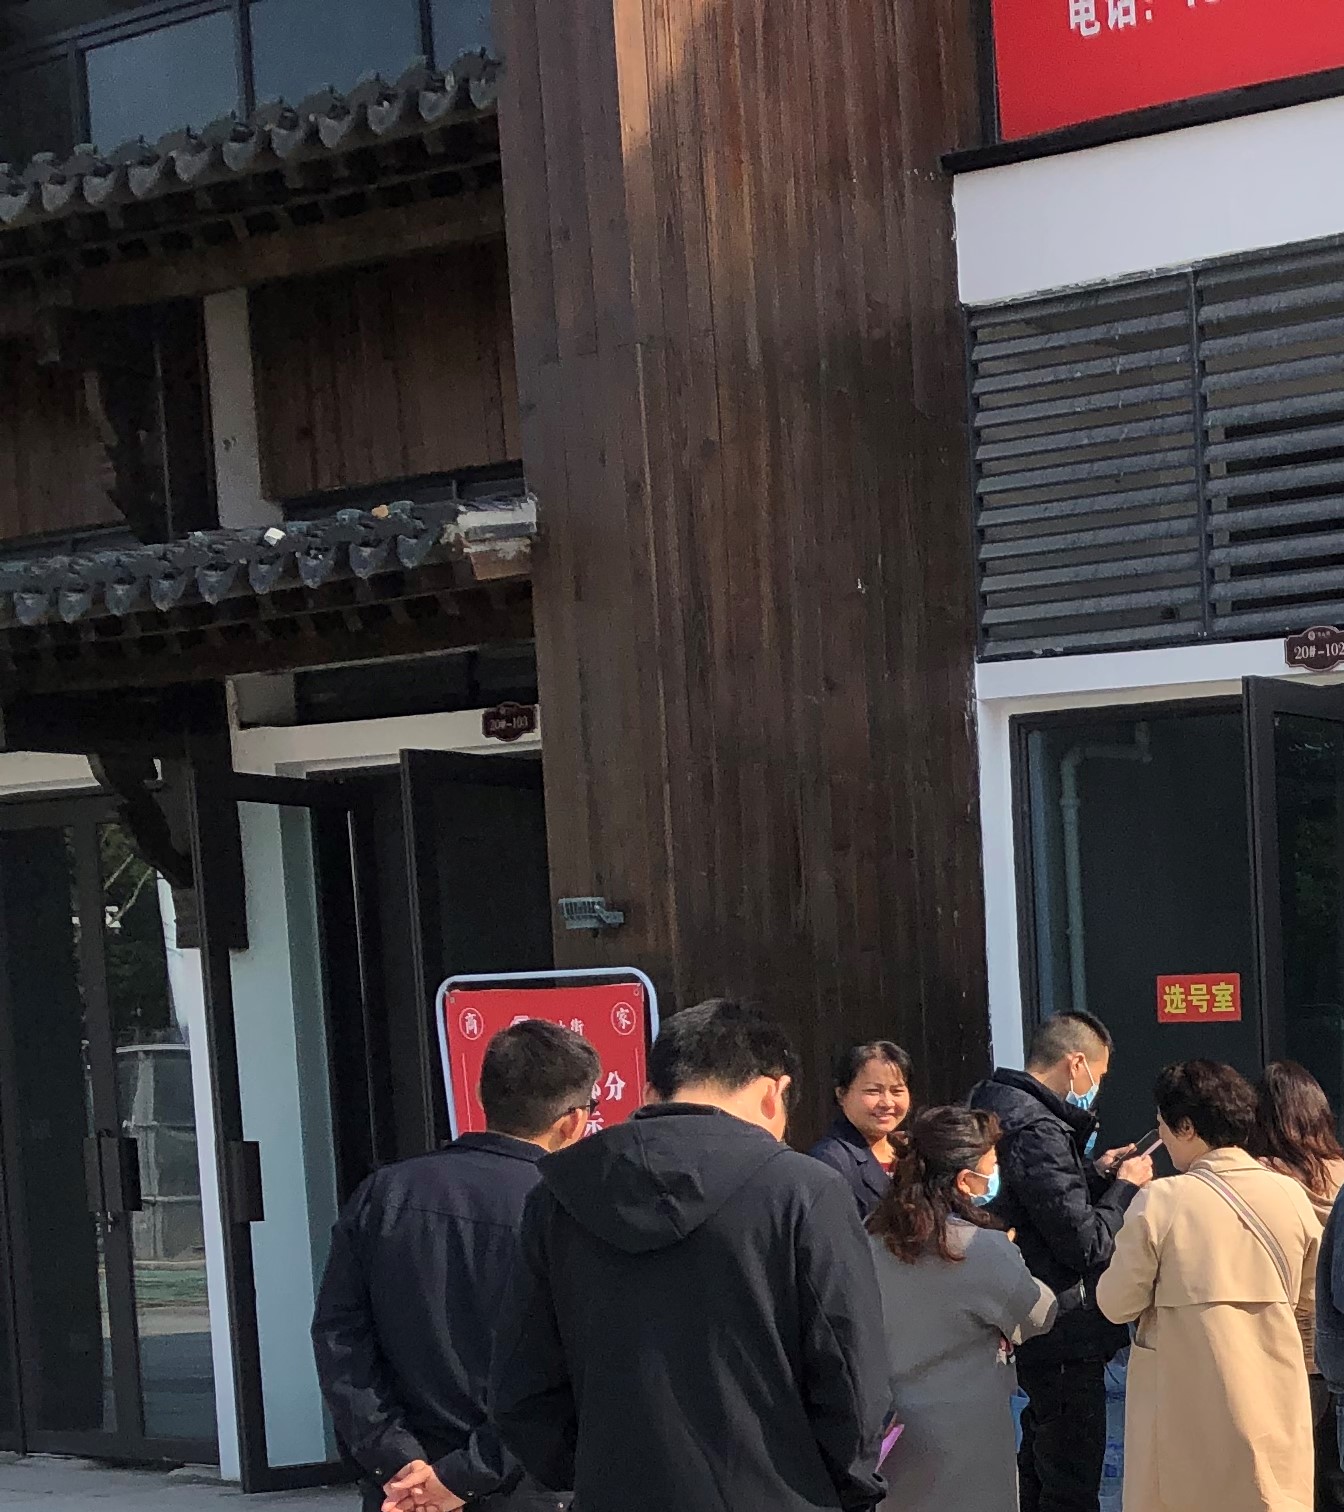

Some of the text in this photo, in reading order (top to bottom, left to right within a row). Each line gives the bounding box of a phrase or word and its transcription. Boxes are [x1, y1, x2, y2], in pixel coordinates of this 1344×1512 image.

[1163, 982, 1236, 1014] 选号室
[616, 1007, 632, 1030] 家
